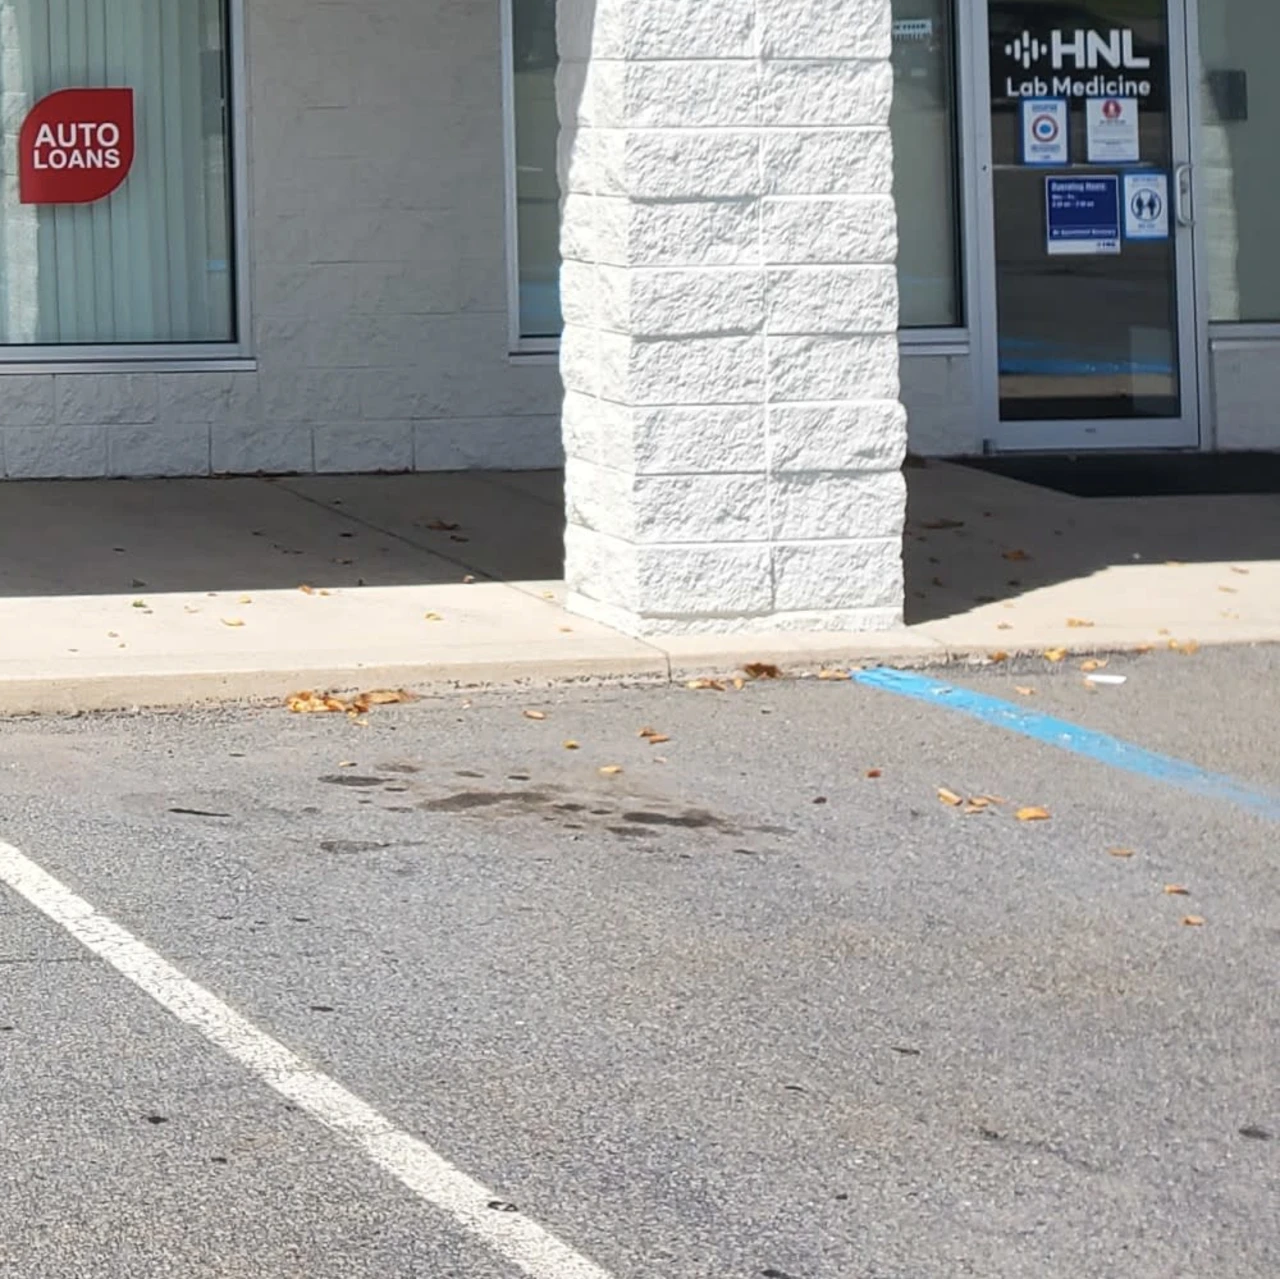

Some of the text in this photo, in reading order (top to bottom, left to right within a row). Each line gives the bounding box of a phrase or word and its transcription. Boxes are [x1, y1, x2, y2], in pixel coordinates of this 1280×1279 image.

[1051, 28, 1151, 69] HNL
[1007, 74, 1151, 96] Lab Medicine
[34, 122, 120, 148] AUTO
[33, 149, 121, 169] LOANS
